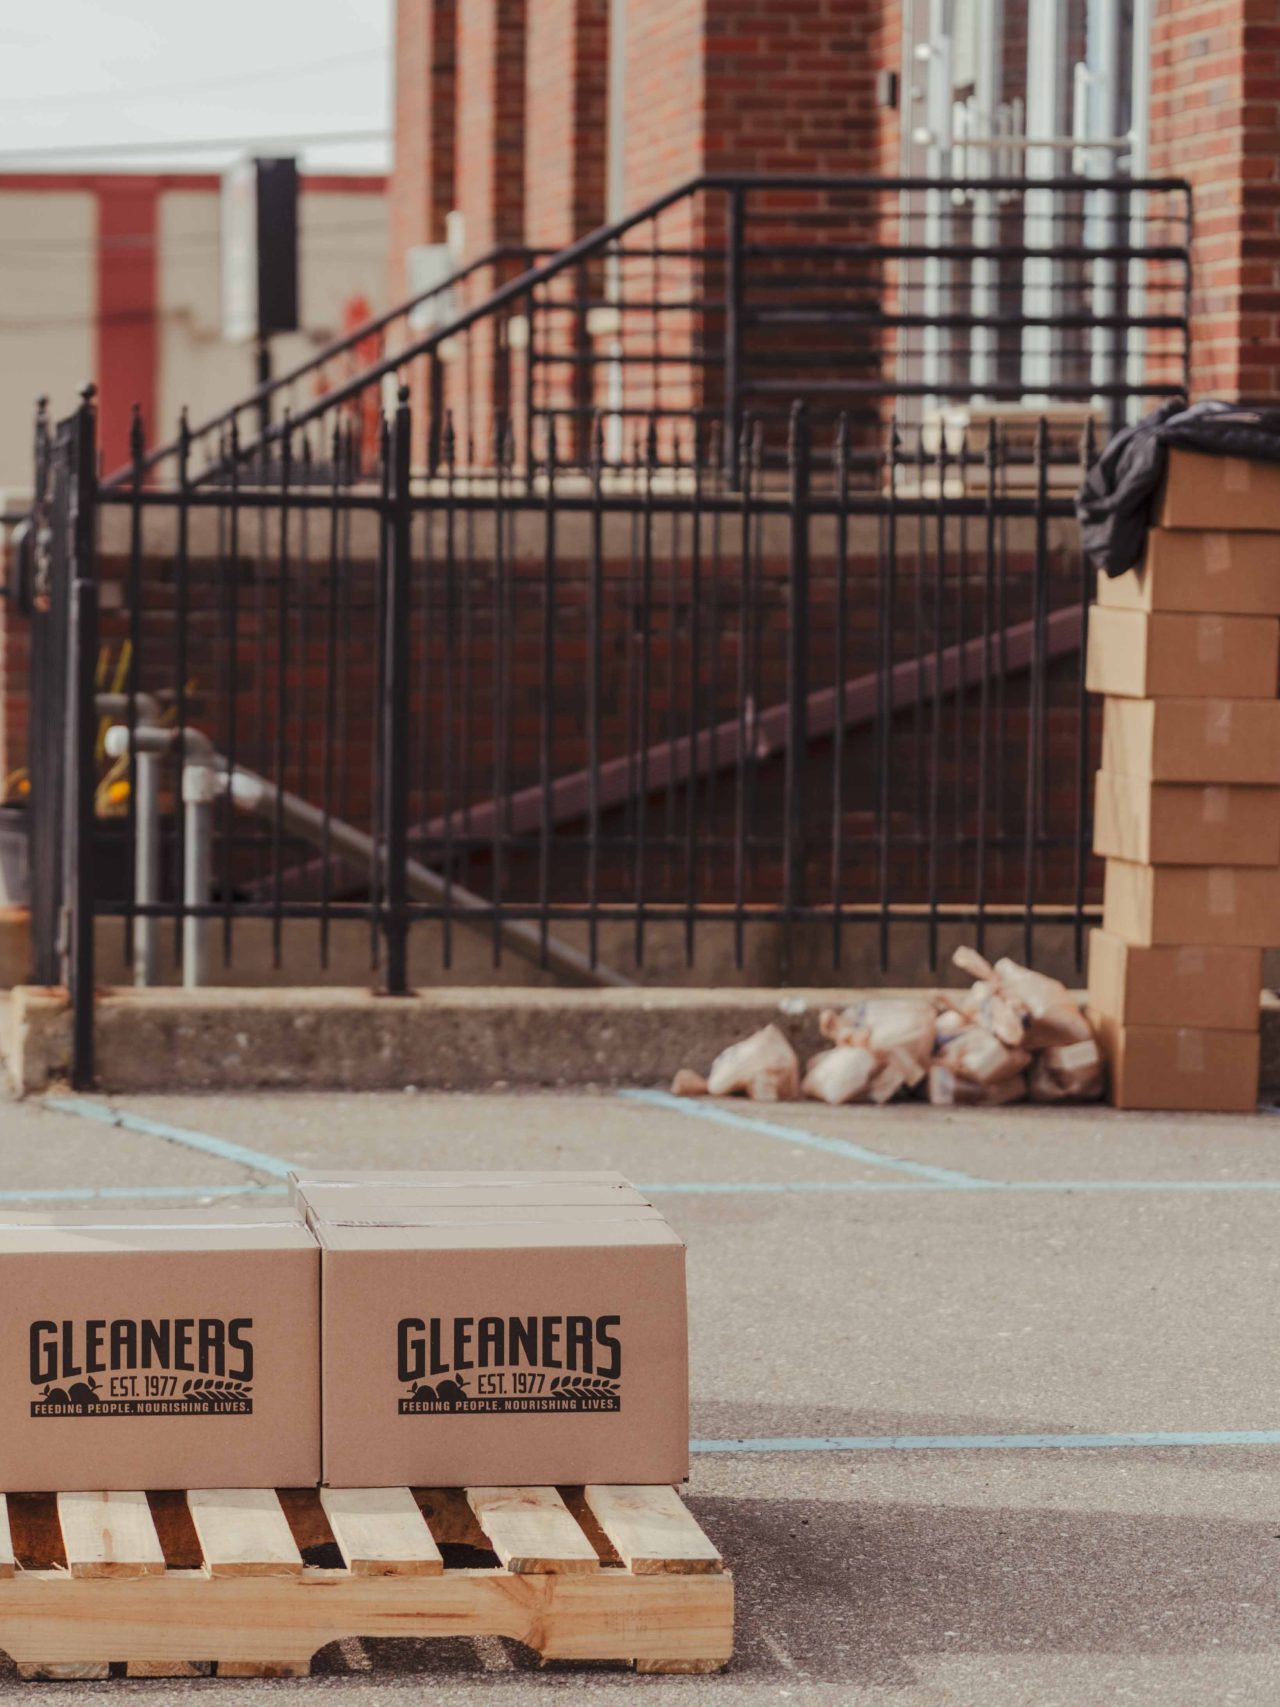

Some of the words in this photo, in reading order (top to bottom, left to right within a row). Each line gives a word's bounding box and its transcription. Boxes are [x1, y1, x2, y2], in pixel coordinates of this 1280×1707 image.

[30, 1318, 254, 1385] GLEANERS
[397, 1315, 621, 1382] GLEANERS
[110, 1376, 140, 1397] EST.
[144, 1375, 178, 1397] 1977
[477, 1373, 507, 1395] EST.
[512, 1373, 546, 1394] 1977
[34, 1403, 83, 1415] FEEDING
[87, 1403, 134, 1415] PEOPLE.
[136, 1402, 209, 1414] NOURISHING
[213, 1401, 250, 1412] LIVES.
[402, 1401, 450, 1412] FEEDING
[455, 1400, 502, 1411] PEOPLE.
[504, 1399, 577, 1411] NOURISHING
[581, 1399, 618, 1410] LIVES.
